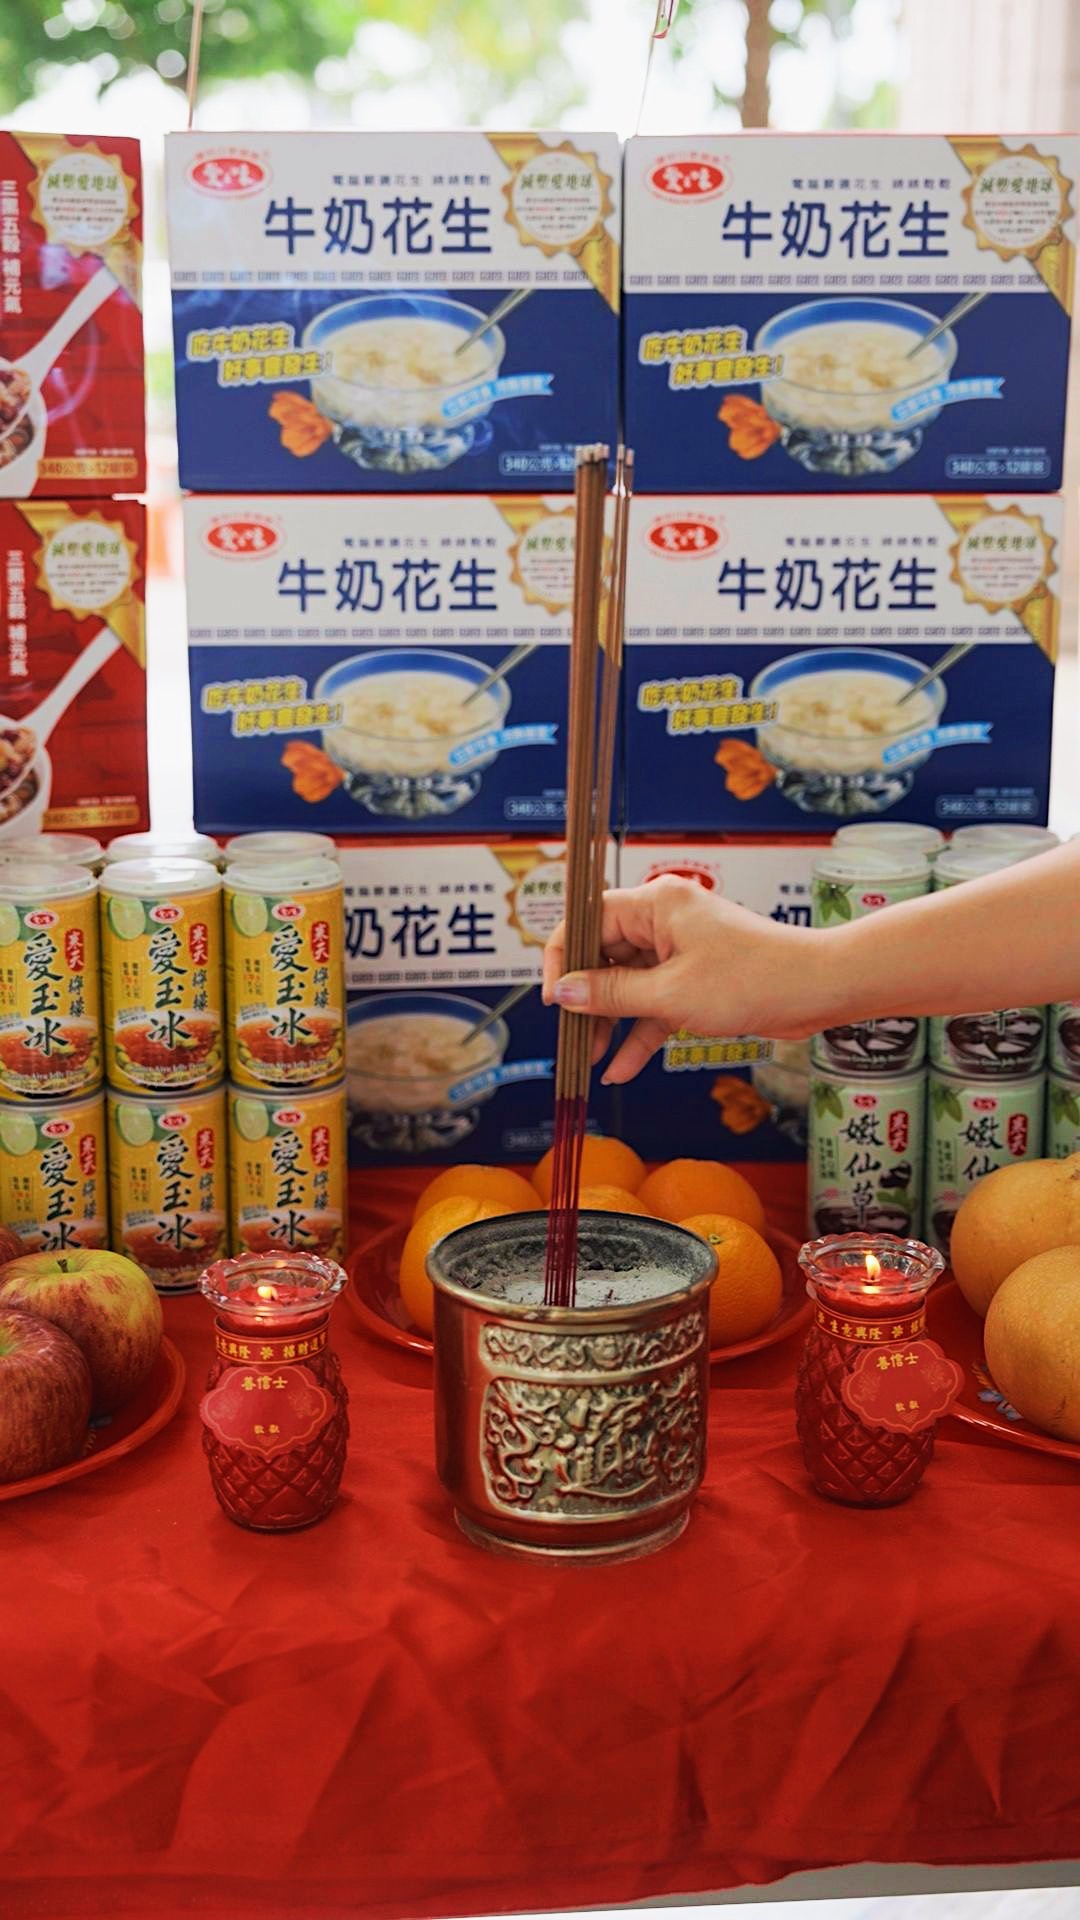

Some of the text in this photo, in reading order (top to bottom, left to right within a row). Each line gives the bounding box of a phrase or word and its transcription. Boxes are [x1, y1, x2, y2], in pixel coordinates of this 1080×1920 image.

[265, 196, 492, 256] 牛奶花生
[722, 200, 949, 259] 牛奶花生
[278, 558, 498, 614] 牛奶花生
[718, 557, 937, 612] 牛奶花生
[67, 931, 85, 969] 寒天
[190, 926, 208, 963] 寒天
[312, 924, 330, 960] 寒天
[24, 932, 68, 1056] 愛玉冰
[69, 975, 85, 1017] 檸檬
[149, 927, 191, 1049] 愛玉冰
[192, 969, 208, 1011] 檸檬
[270, 925, 312, 1045] 愛玉冰
[314, 967, 330, 1008] 檸檬
[80, 1135, 97, 1175] 寒天
[197, 1130, 215, 1167] 寒天
[312, 1127, 329, 1164] 寒天
[270, 1130, 312, 1247] 愛玉冰
[839, 1112, 884, 1226] 嫩仙草
[40, 1141, 82, 1250] 愛玉冰
[82, 1178, 97, 1218] 檸檬
[156, 1134, 198, 1251] 愛玉冰
[199, 1171, 216, 1213] 檸檬
[312, 1171, 329, 1212] 檸檬
[830, 1319, 883, 1340] 生意興隆
[876, 1352, 919, 1370] 善信士
[241, 1375, 288, 1392] 善信士
